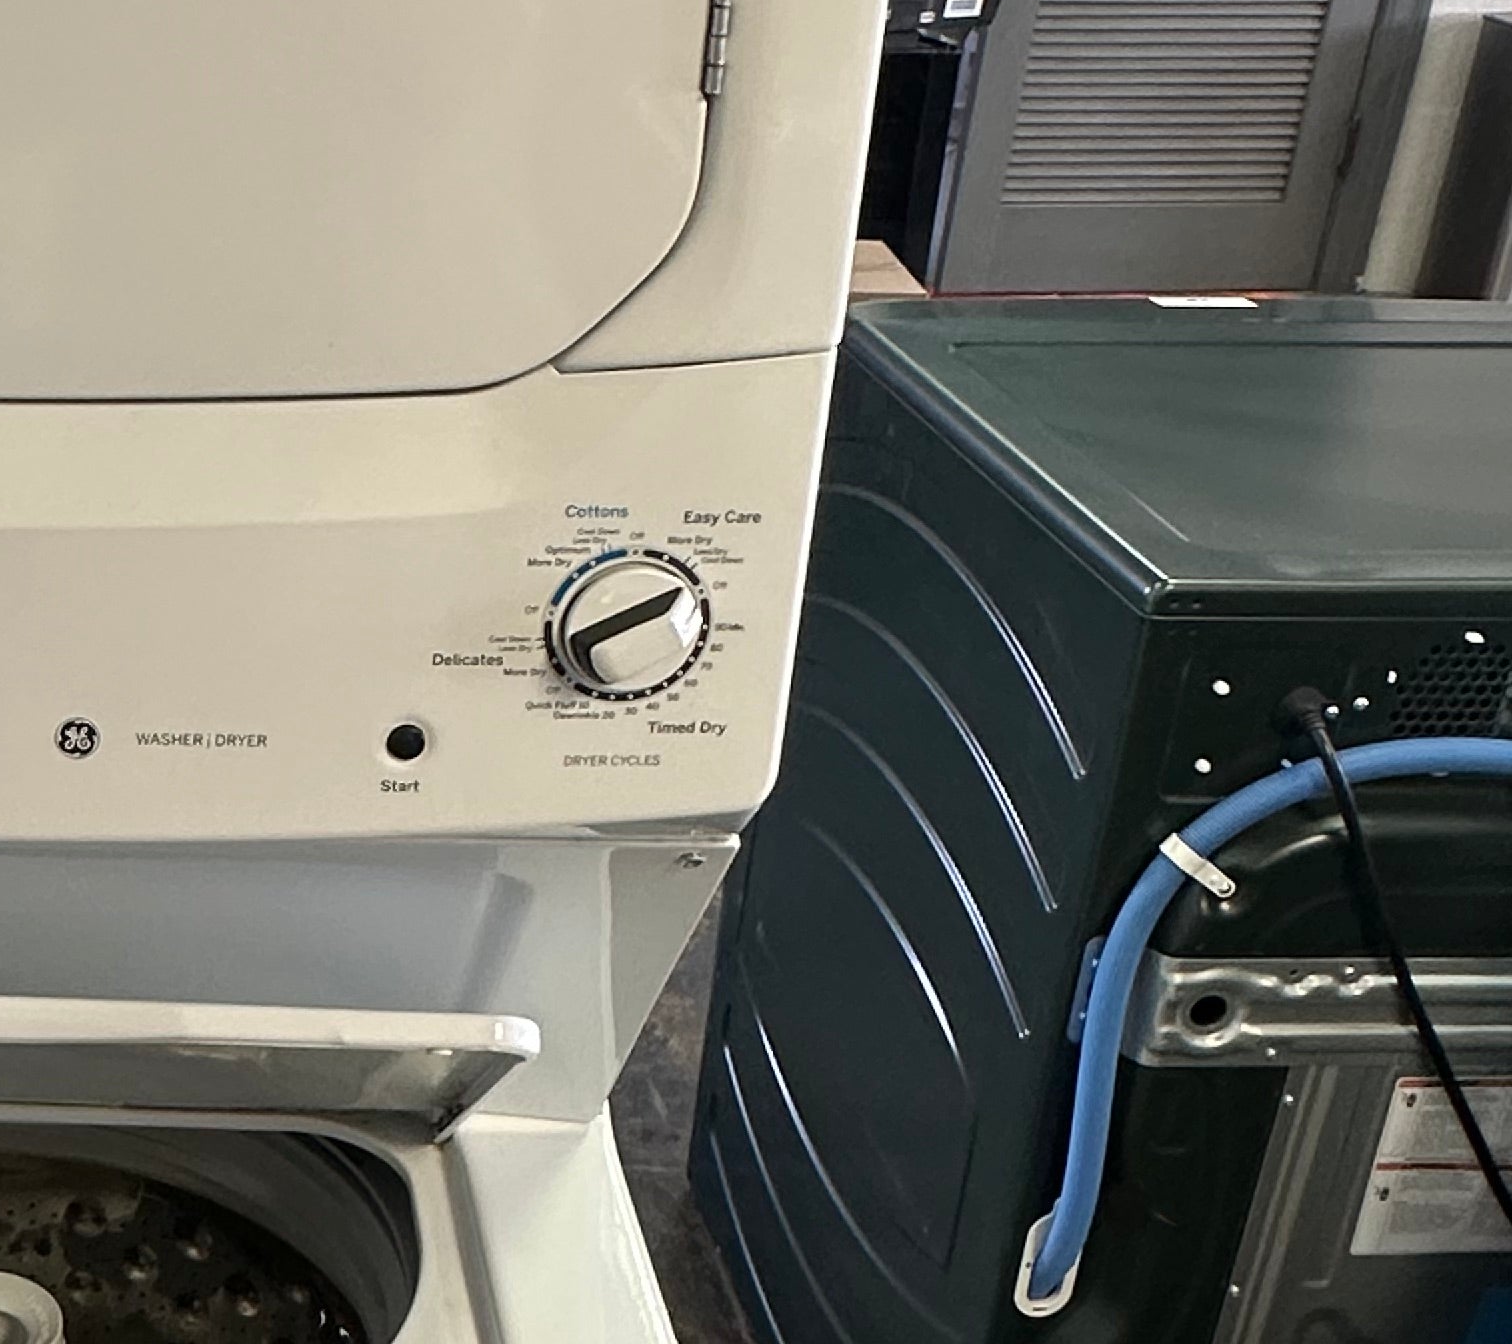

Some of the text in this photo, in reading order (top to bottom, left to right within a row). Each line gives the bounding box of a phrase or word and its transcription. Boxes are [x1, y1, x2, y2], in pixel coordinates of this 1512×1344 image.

[565, 503, 629, 518] Cottons
[684, 509, 762, 526] Easy Care
[695, 535, 713, 545] Dry
[545, 545, 591, 555] Optimum
[527, 558, 572, 568] More Dry
[432, 653, 503, 666] Delicates
[503, 668, 546, 678] More Dry
[647, 721, 728, 736] Timed Dry
[135, 732, 204, 748] WASHER
[214, 733, 268, 749] DRYER
[563, 754, 661, 768] DRYER CYCLES
[380, 778, 420, 794] Start
